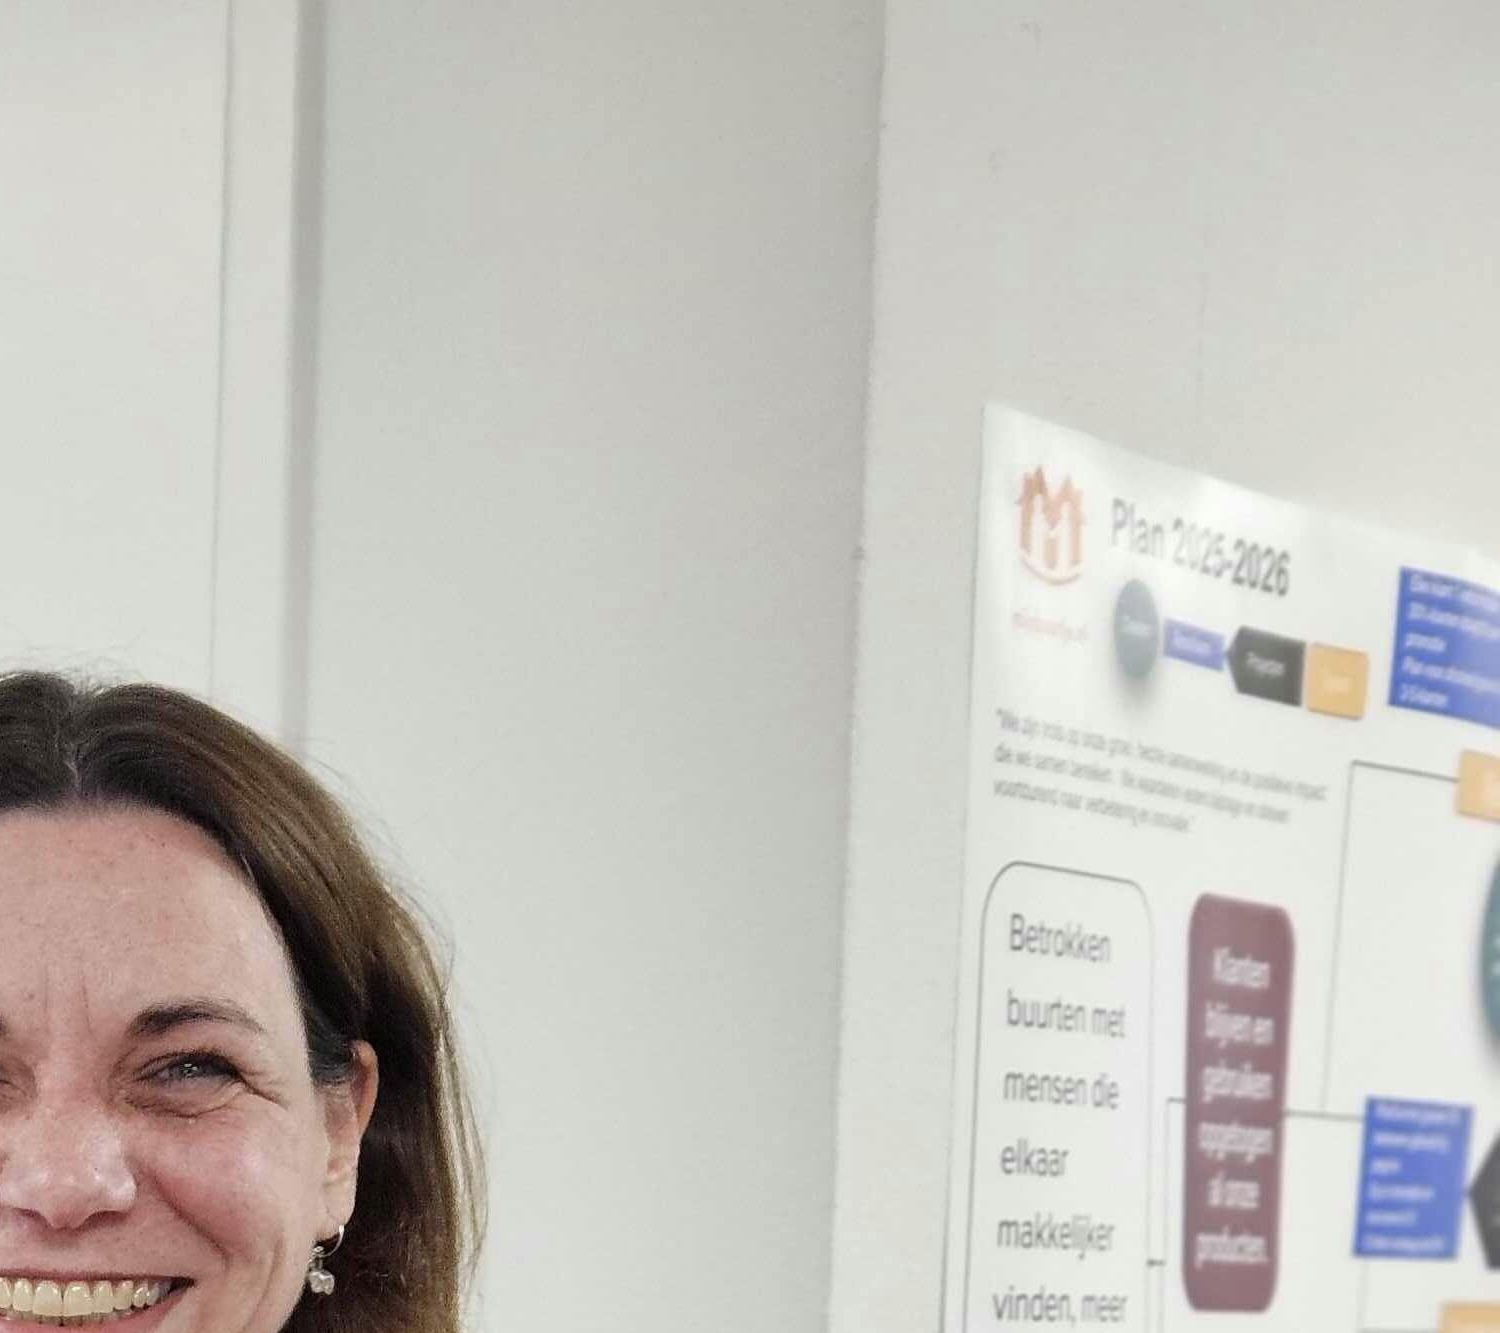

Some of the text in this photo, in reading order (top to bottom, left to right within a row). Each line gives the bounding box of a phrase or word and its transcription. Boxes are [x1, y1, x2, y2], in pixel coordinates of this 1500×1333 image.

[1111, 497, 1165, 558] Plan
[1009, 913, 1111, 963] Betrokken
[1006, 988, 1127, 1039] buurten met
[1004, 1069, 1120, 1110] mensen die
[1000, 1138, 1069, 1177] elkaar
[997, 1212, 1116, 1260] makkelijker
[993, 1286, 1128, 1325] vinden, meer
